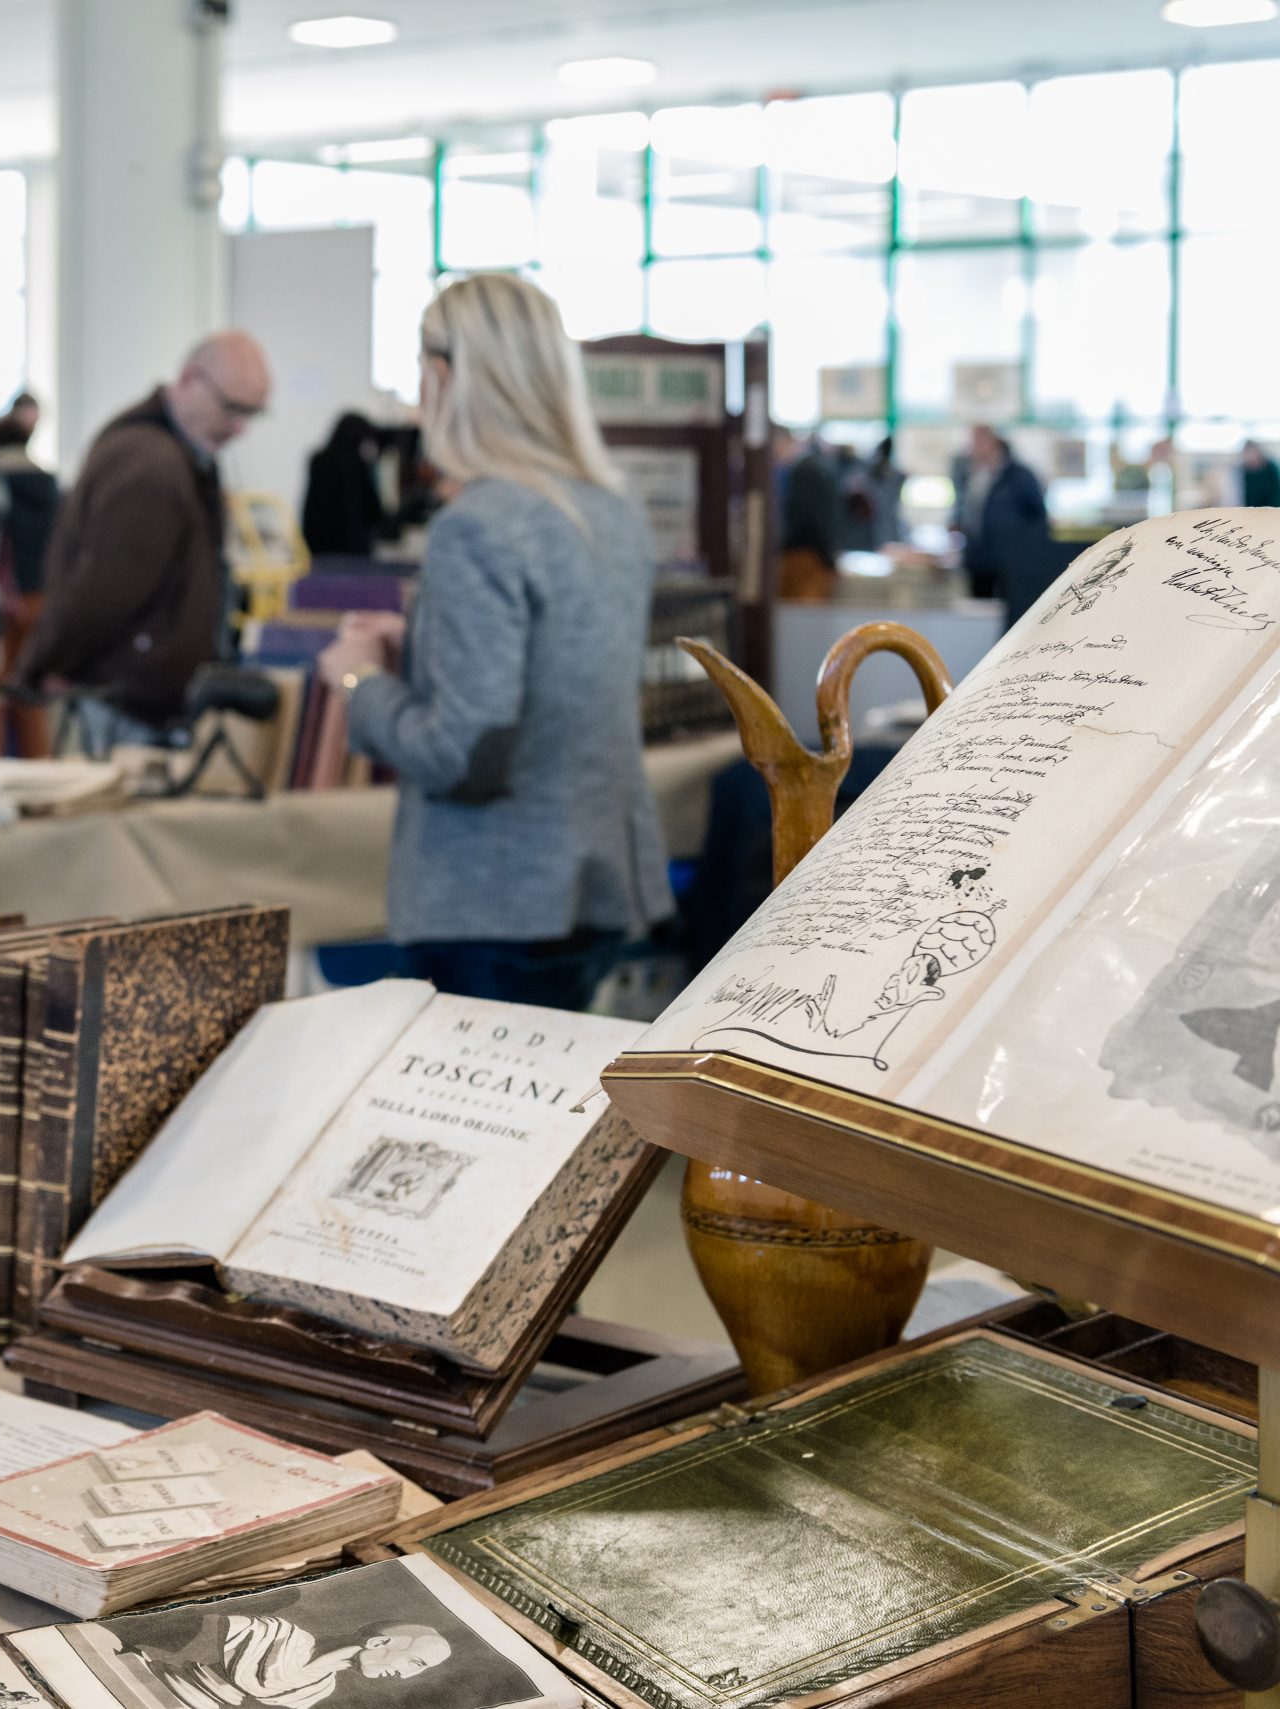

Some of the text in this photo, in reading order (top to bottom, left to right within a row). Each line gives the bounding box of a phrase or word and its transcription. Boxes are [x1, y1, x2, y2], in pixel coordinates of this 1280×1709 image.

[453, 1019, 576, 1053] MODI
[399, 1053, 570, 1105] TOSCANI
[369, 1096, 416, 1117] NELLA
[419, 1107, 462, 1126] LORO
